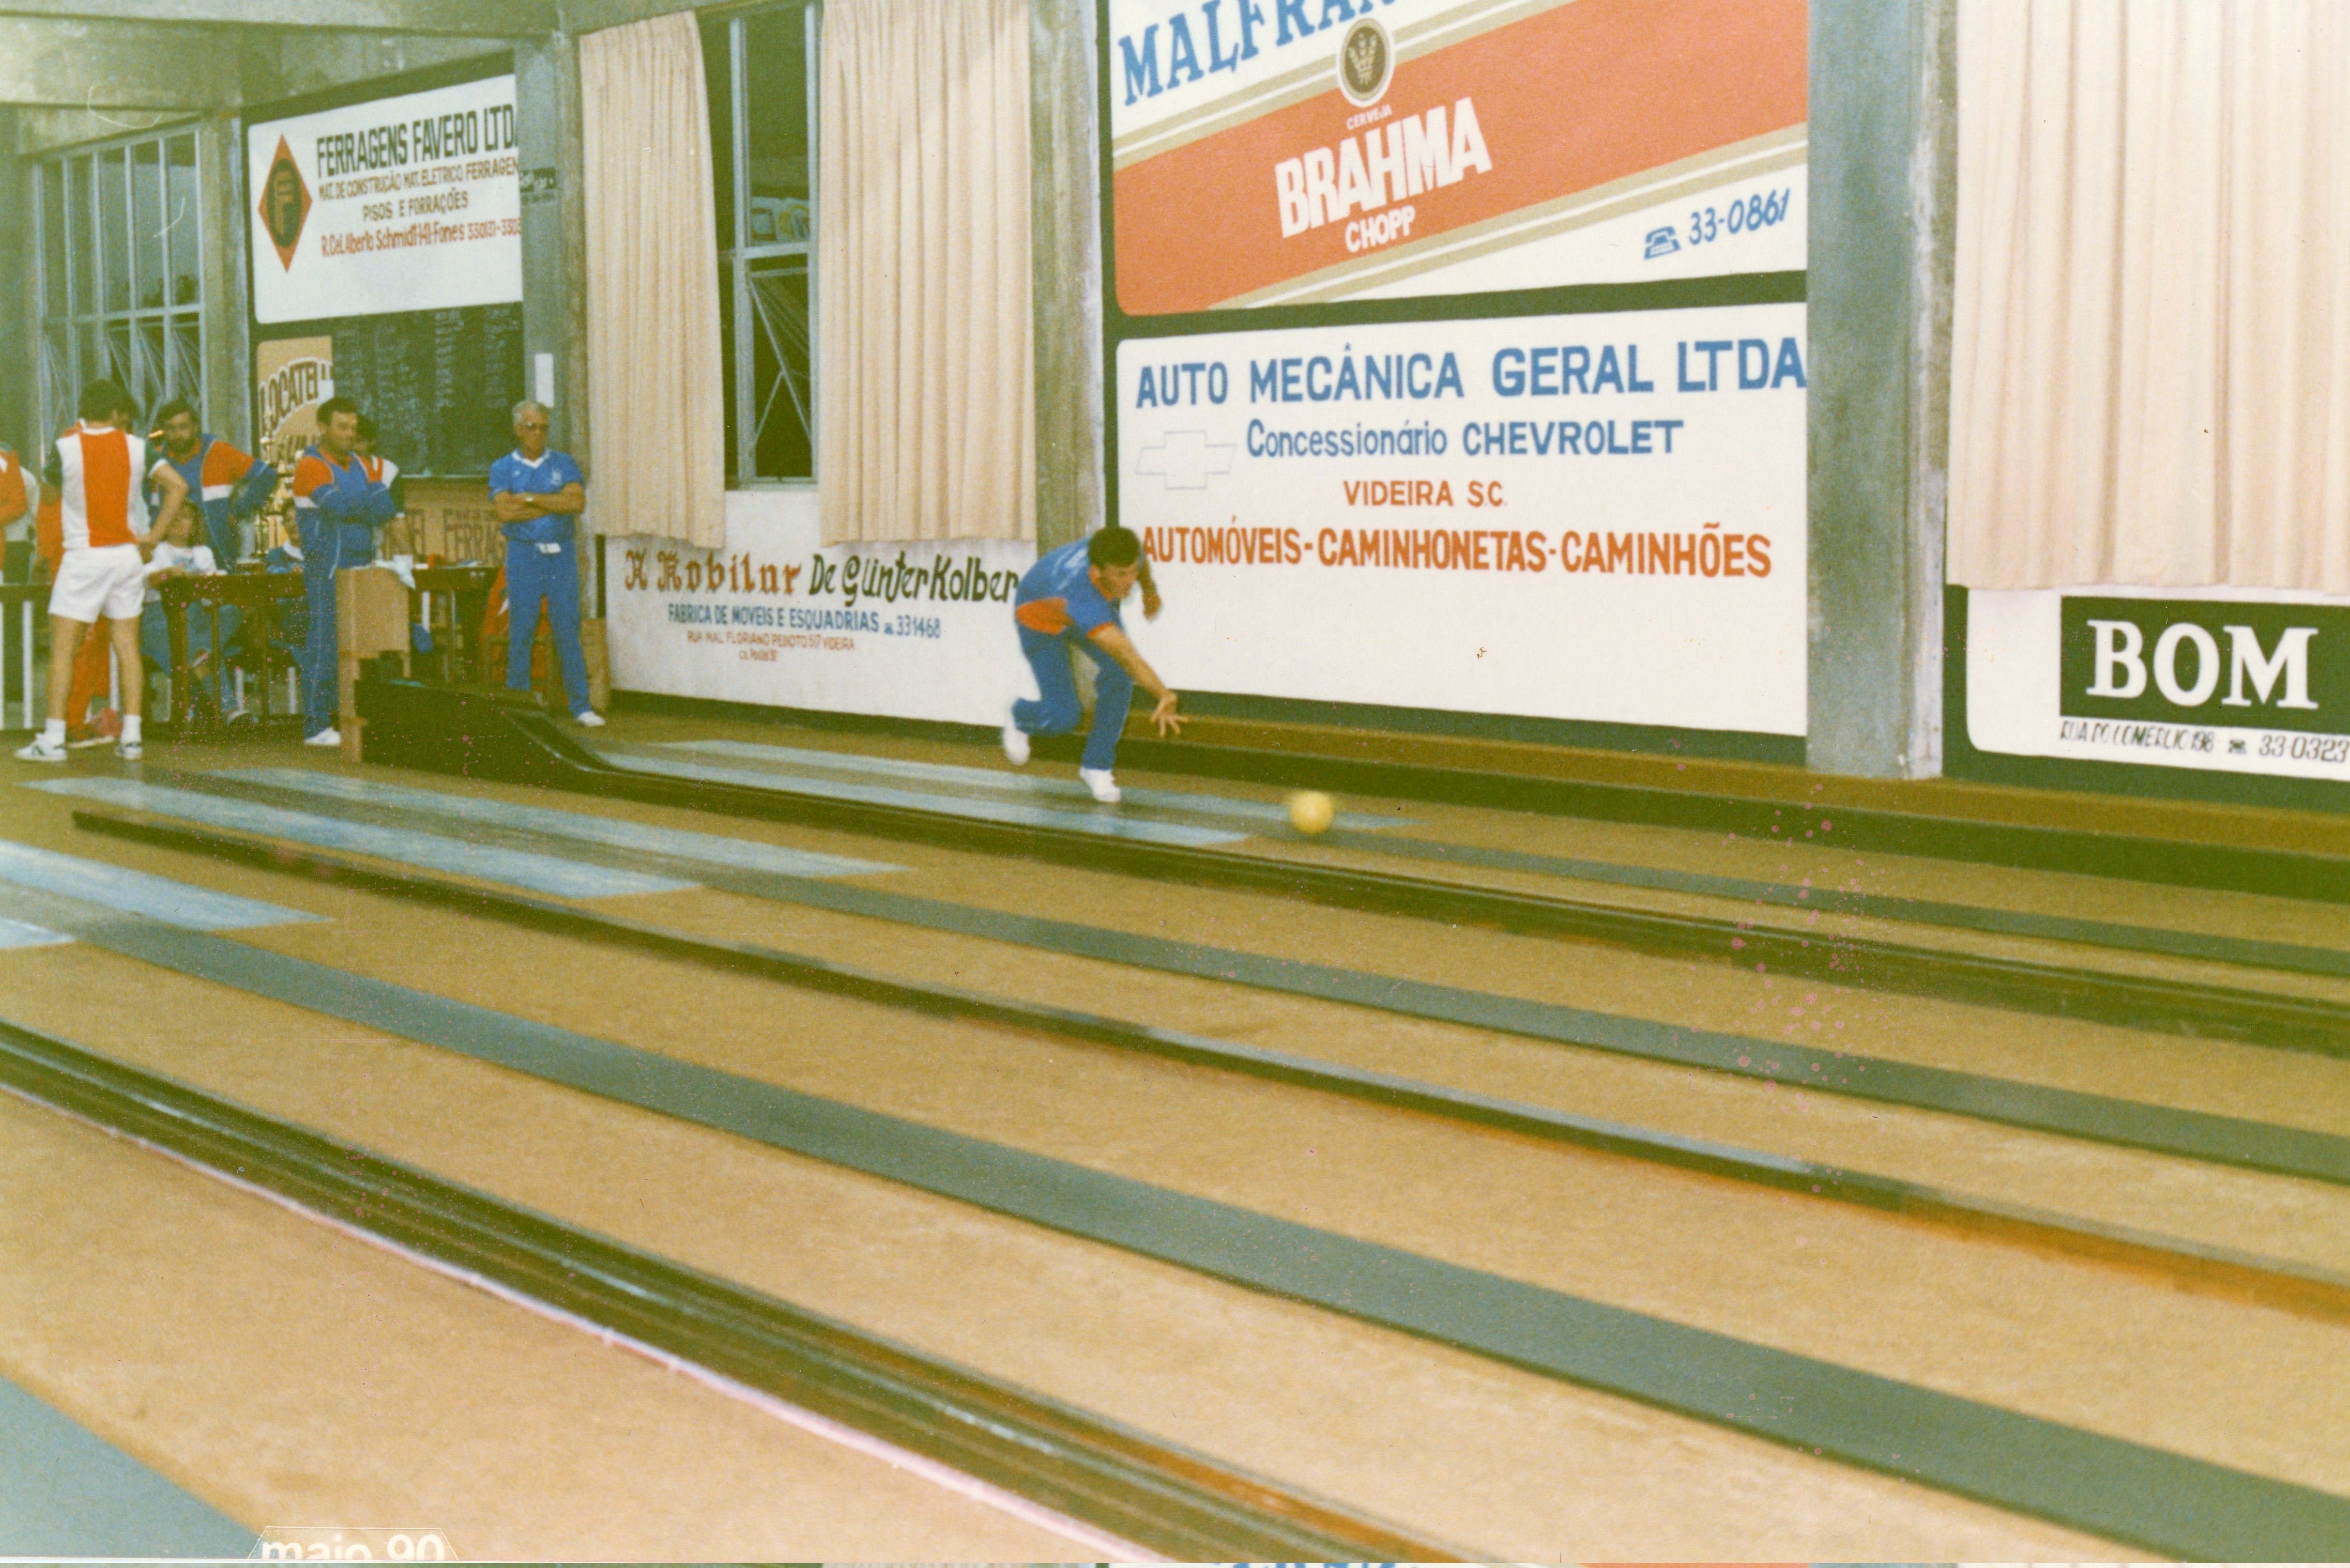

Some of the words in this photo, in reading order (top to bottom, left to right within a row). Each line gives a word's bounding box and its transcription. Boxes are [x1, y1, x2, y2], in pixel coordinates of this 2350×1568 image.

[1346, 103, 1393, 130] CERVEJA
[317, 123, 407, 178] FERRAGENS
[413, 110, 478, 162] FAVERO
[483, 103, 518, 151] LTD
[1275, 97, 1492, 239] BRAHMA
[363, 201, 393, 223] PISOS
[400, 199, 405, 217] E
[408, 187, 468, 215] FORRAÇÕES
[1688, 188, 1790, 245] 33-0861
[1346, 206, 1416, 253] CHOPP
[1136, 361, 1229, 409] AUTO
[1250, 342, 1465, 404] MECÂNICA
[1492, 344, 1654, 397] GERAL
[1677, 337, 1808, 393] LTDA
[1247, 418, 1447, 458] Concessionário
[1463, 420, 1685, 456] CHEVROLET
[1344, 480, 1455, 506] VIDEIRA
[808, 553, 836, 595] De
[668, 603, 711, 624] FABRICA
[714, 604, 727, 624] DE
[732, 605, 774, 627] MOVEIS
[777, 607, 785, 627] E
[789, 608, 879, 634] ESQUADRIAS
[2085, 619, 2320, 710] BOM
[2060, 720, 2087, 743] RUA
